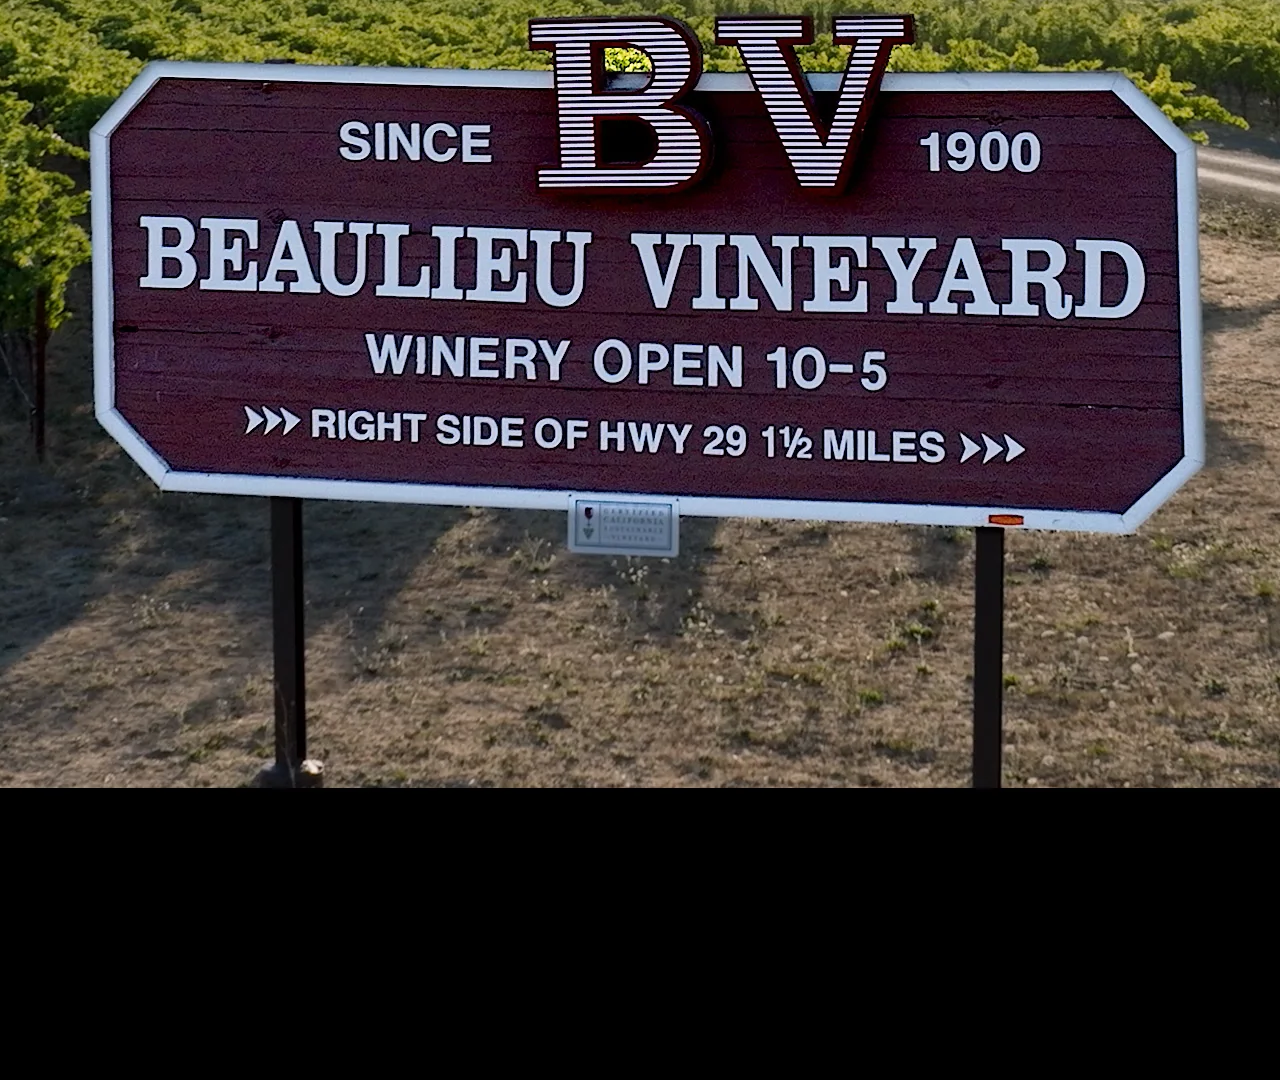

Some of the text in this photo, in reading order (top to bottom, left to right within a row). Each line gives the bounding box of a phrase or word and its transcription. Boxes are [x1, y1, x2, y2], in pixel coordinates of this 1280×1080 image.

[530, 16, 906, 190] BV
[338, 120, 1042, 174] SINCE 1900
[138, 214, 1147, 321] BEAULIEU VINEYARD
[363, 332, 888, 392] WINERY OPEN 10-5
[310, 407, 428, 444] RIGHT
[435, 412, 526, 449] SIDE
[533, 416, 590, 451] OF
[599, 419, 694, 455] HWY
[701, 424, 748, 458] 29
[822, 428, 947, 464] MILES
